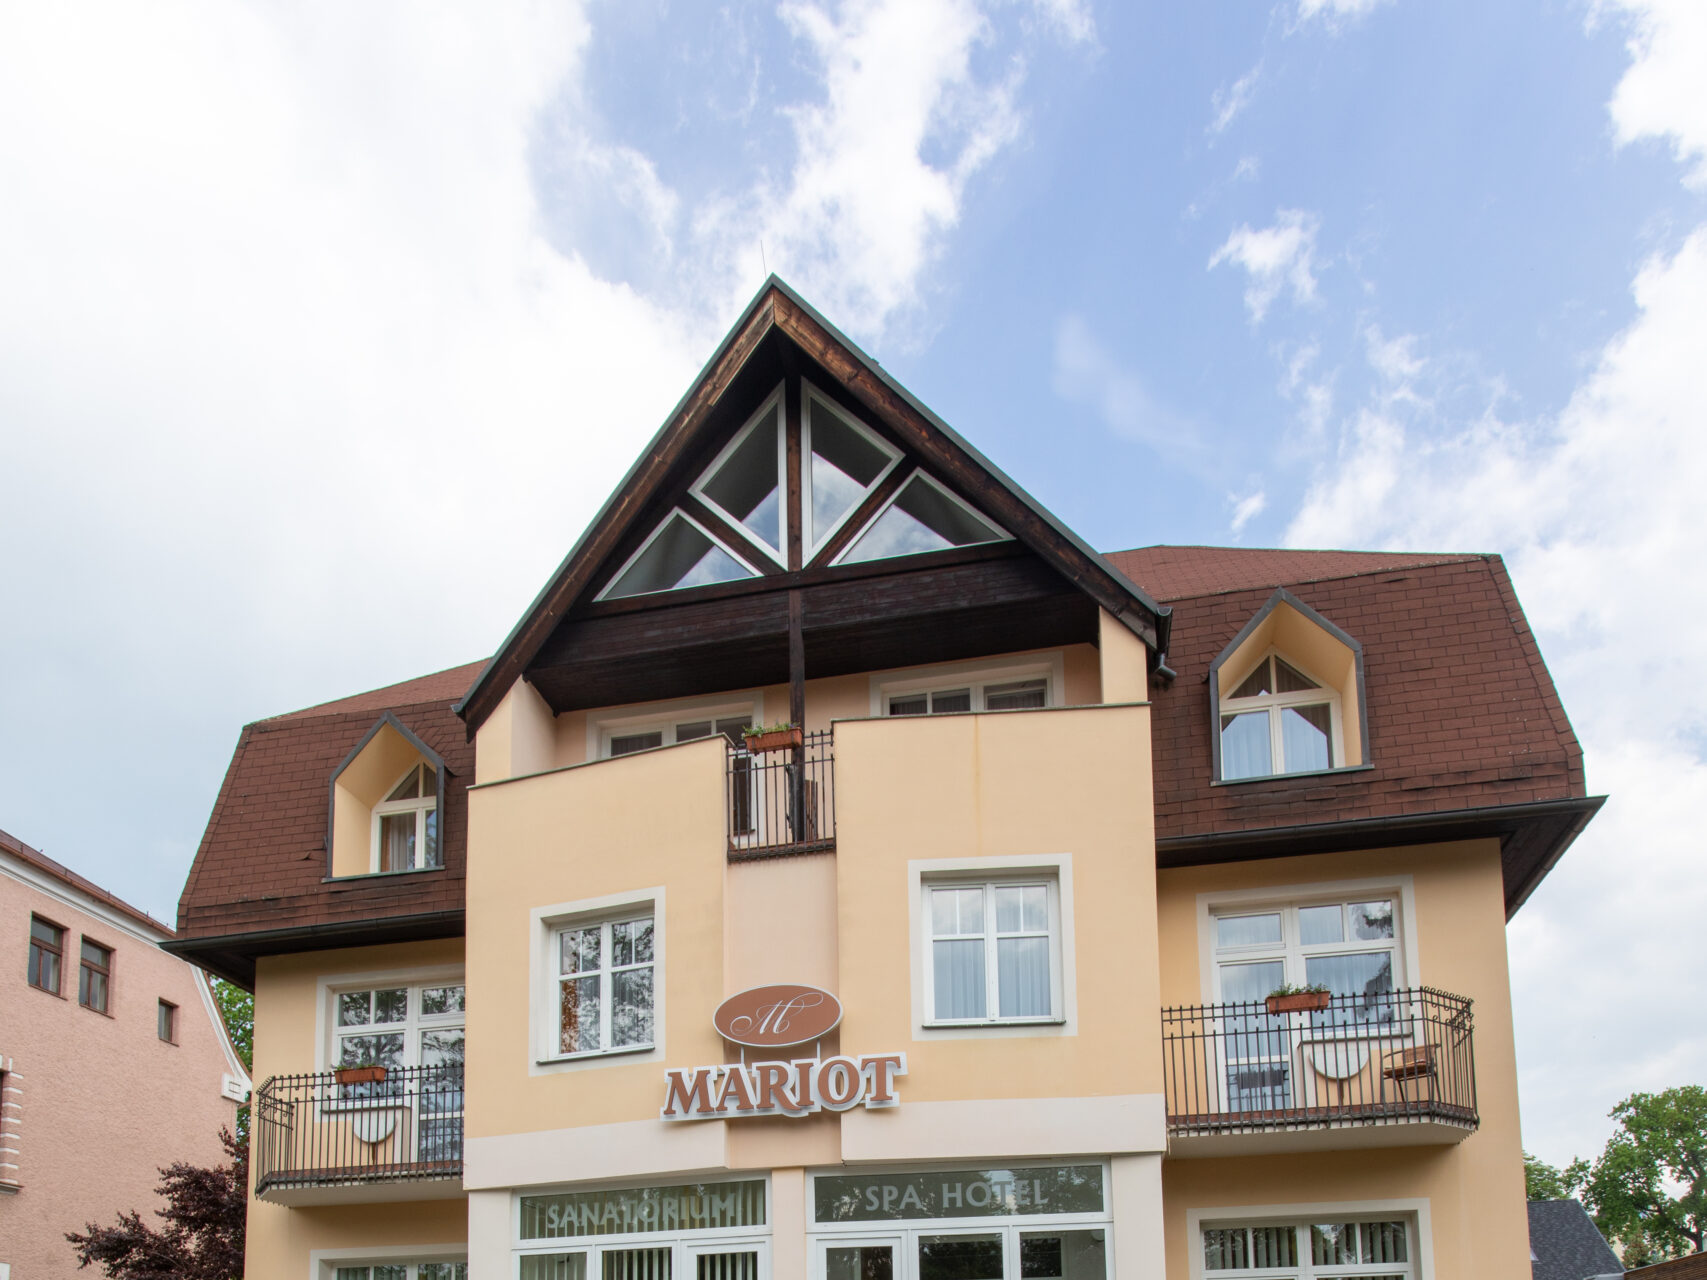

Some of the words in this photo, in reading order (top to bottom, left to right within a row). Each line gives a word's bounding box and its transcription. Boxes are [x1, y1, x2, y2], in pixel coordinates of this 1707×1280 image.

[662, 1054, 904, 1117] MARIOT
[547, 1191, 736, 1229] SANATORIUM
[865, 1184, 923, 1211] SPA
[942, 1179, 1049, 1208] HOTEL
